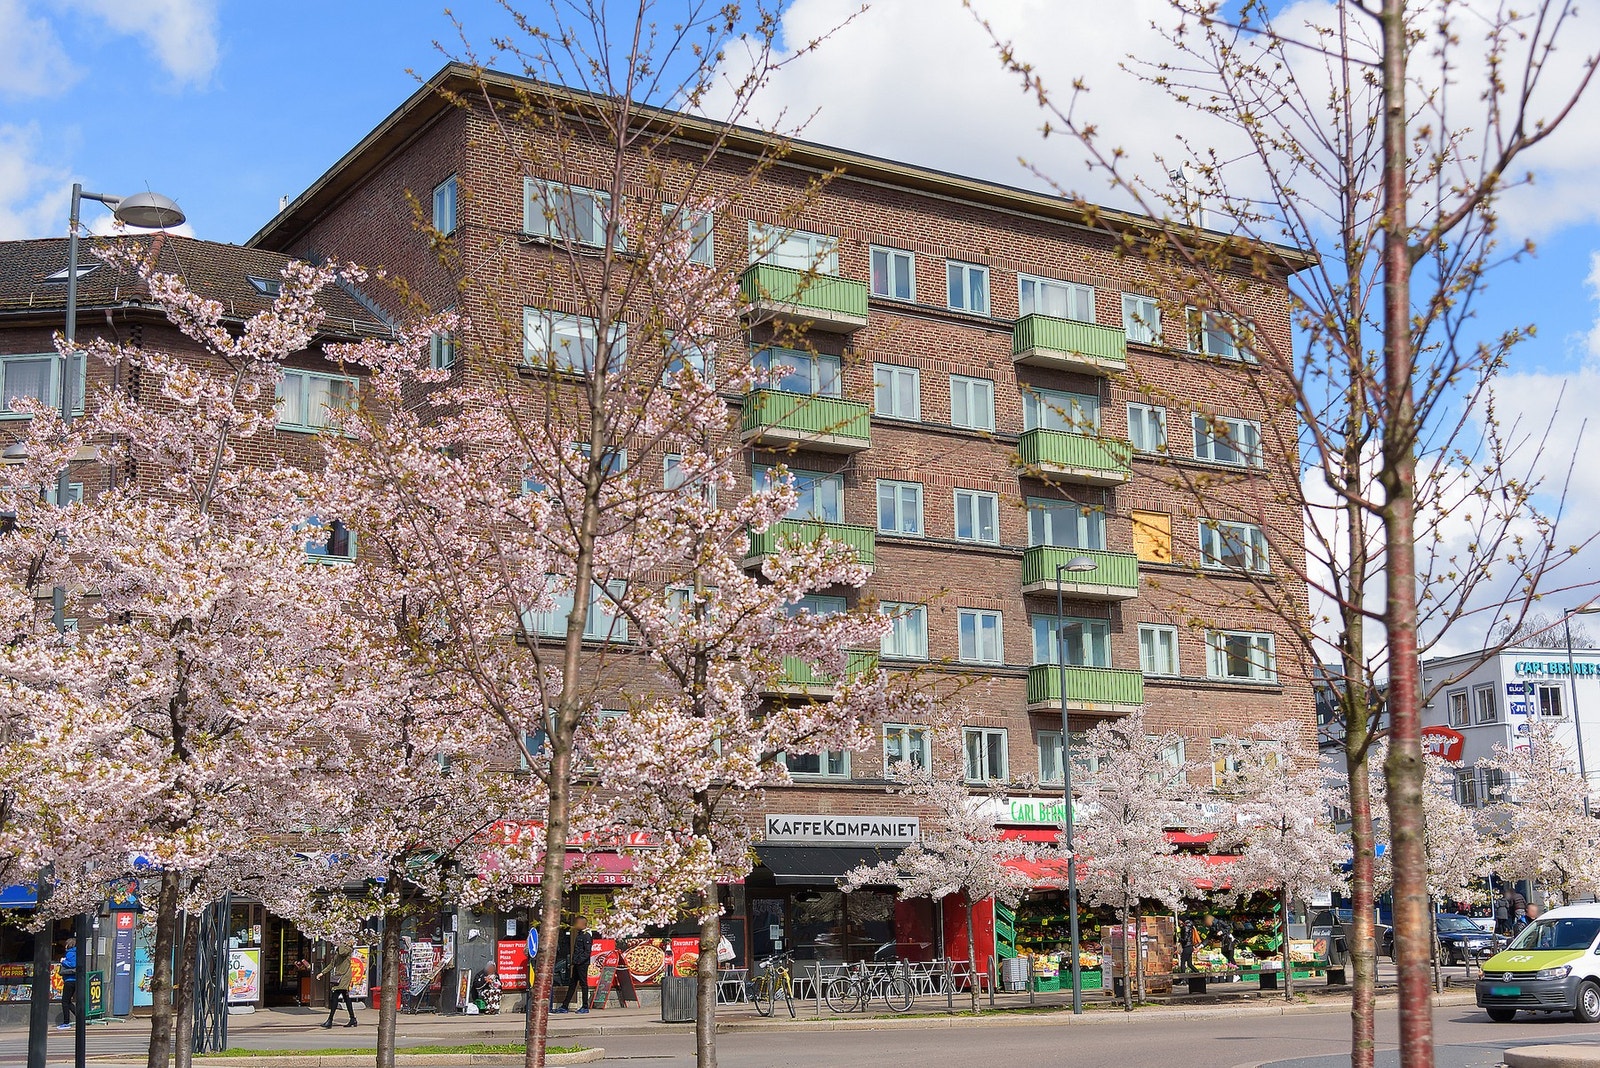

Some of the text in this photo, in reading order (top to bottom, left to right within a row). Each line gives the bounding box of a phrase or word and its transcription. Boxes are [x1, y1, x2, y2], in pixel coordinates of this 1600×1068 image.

[1515, 661, 1545, 675] CARL
[1011, 801, 1036, 822] CARL
[768, 819, 917, 836] KAFFEKOMPANIET
[604, 875, 616, 884] 38
[90, 986, 101, 1000] 90
